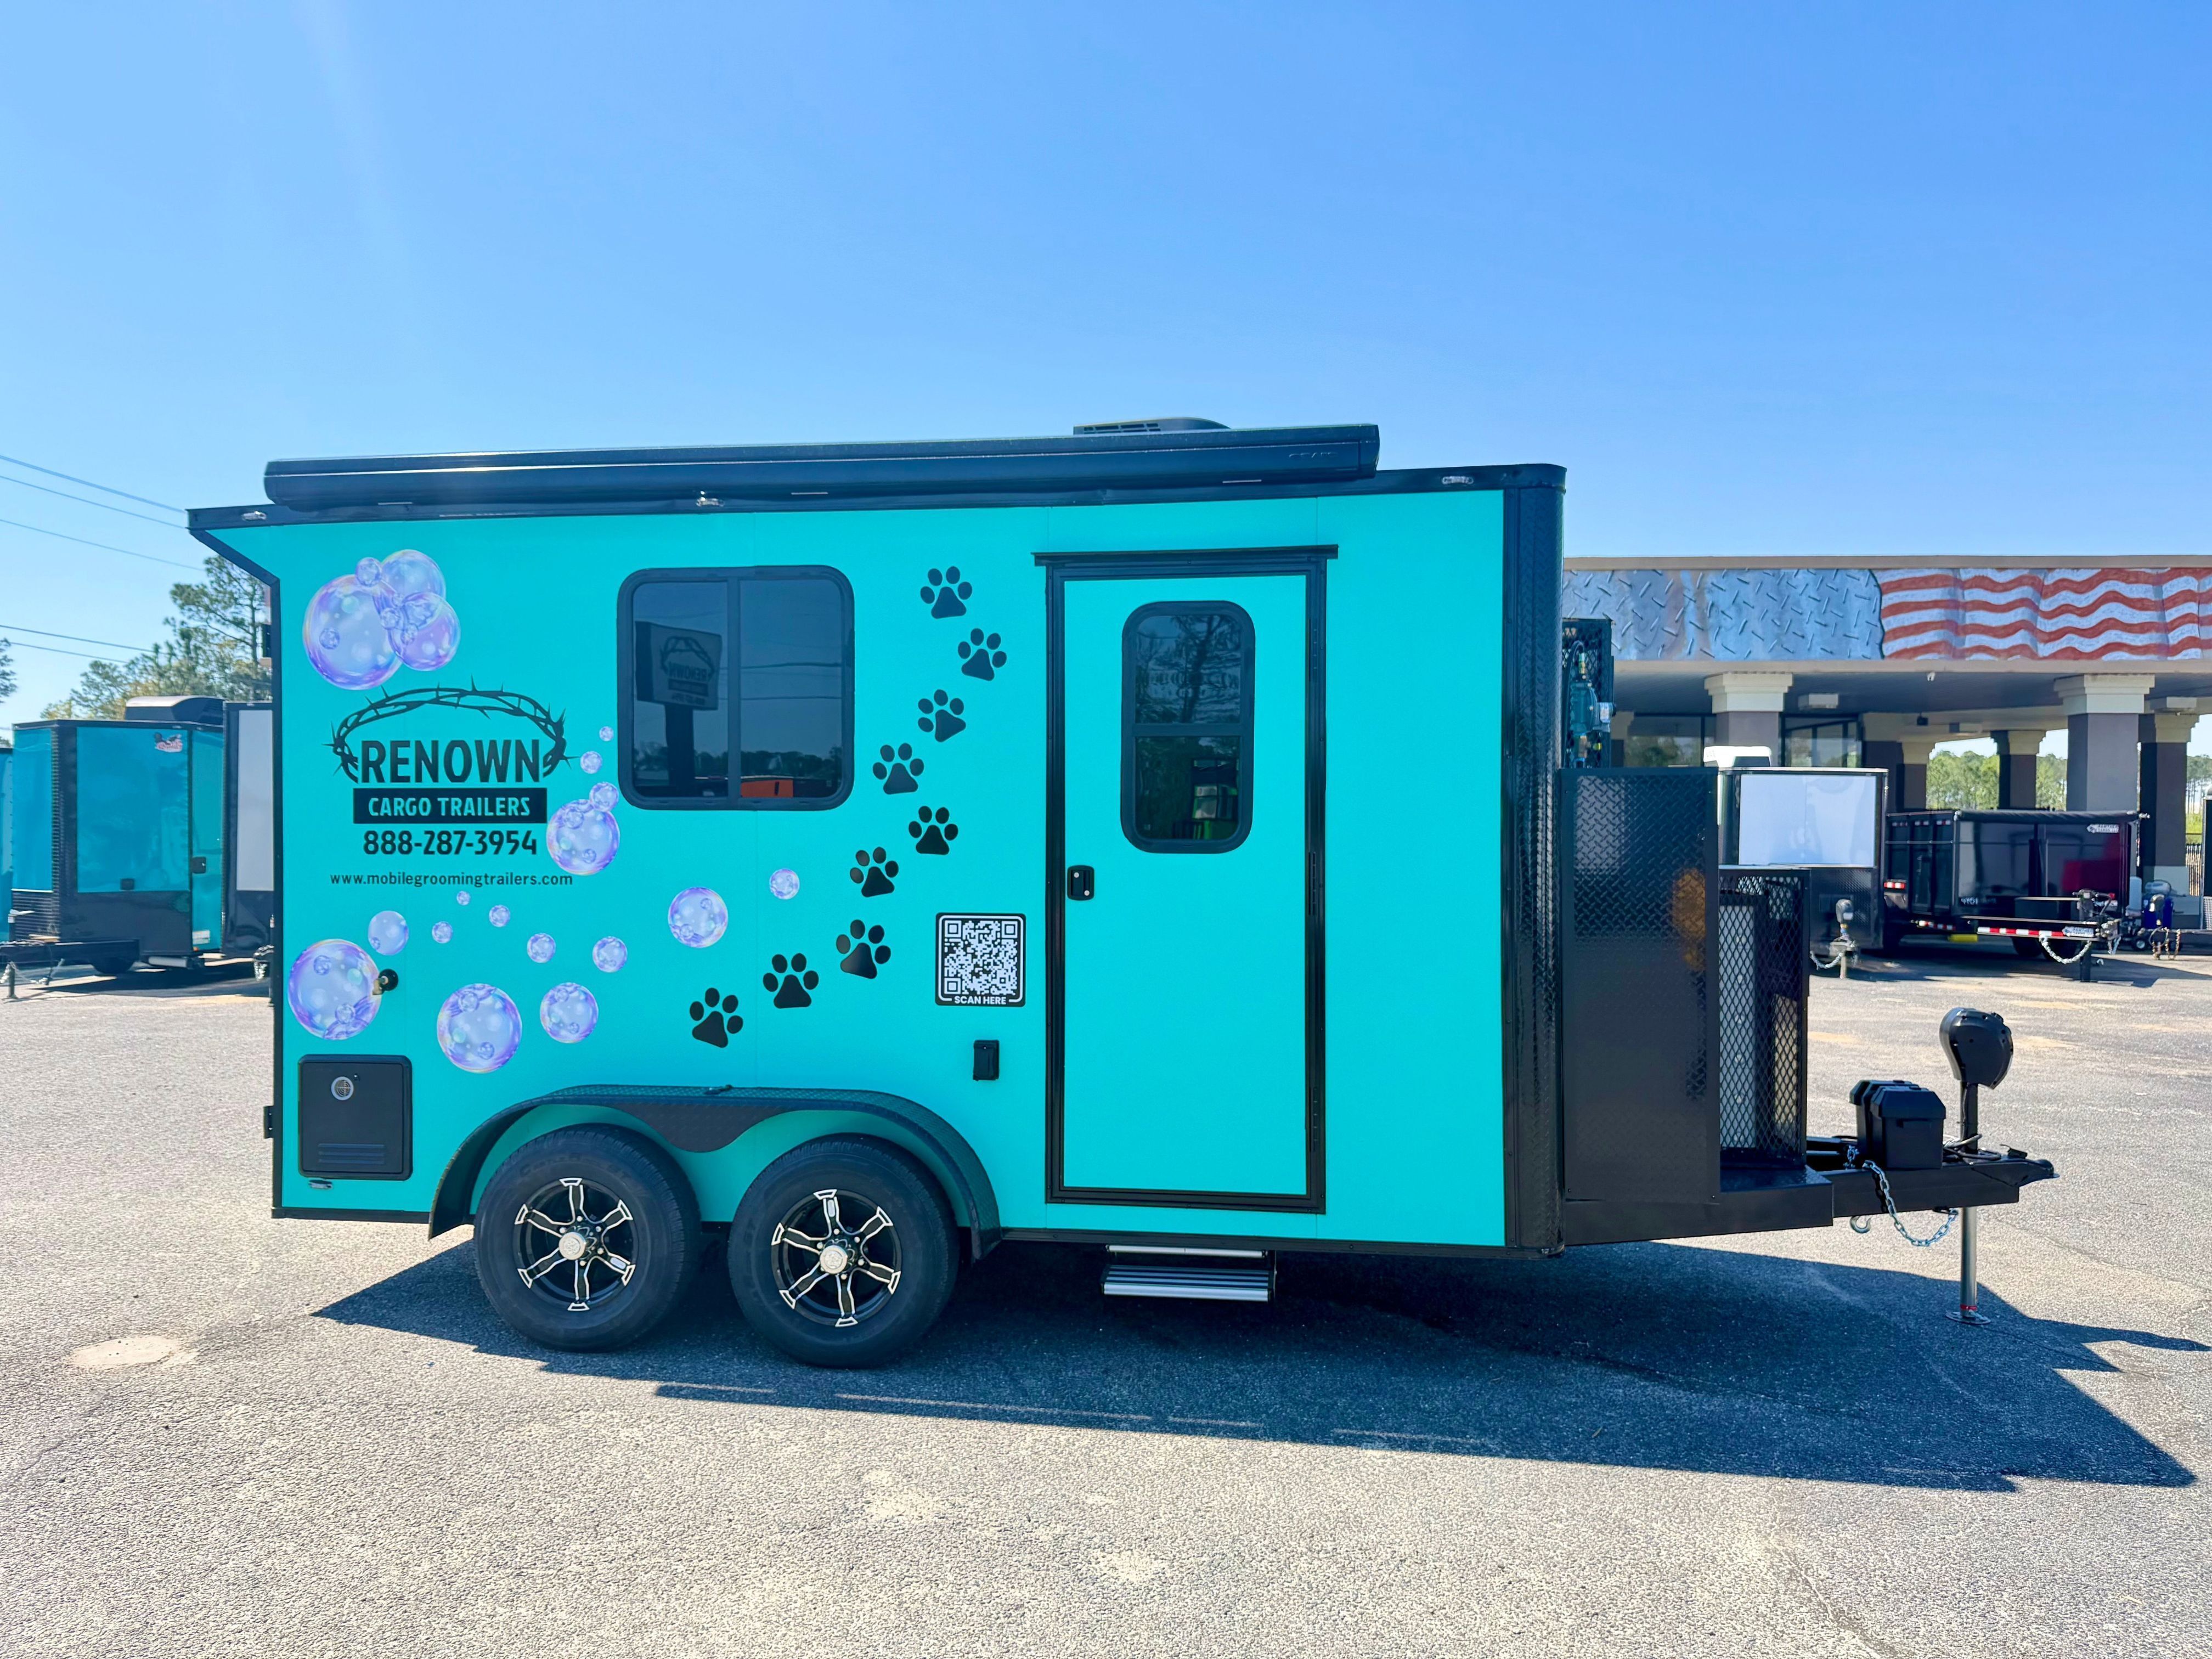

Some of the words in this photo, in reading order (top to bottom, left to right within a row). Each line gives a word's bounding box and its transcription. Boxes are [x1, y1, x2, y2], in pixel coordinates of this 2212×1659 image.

[361, 739, 540, 783] RENOWN
[368, 797, 432, 816] CARGO
[437, 797, 530, 816] TRAILERS
[363, 830, 537, 855] 888-287-3954
[330, 871, 573, 888] www.mobilegroomingtrailers.com
[954, 996, 981, 1004] SCAN
[983, 996, 1006, 1005] HERE
